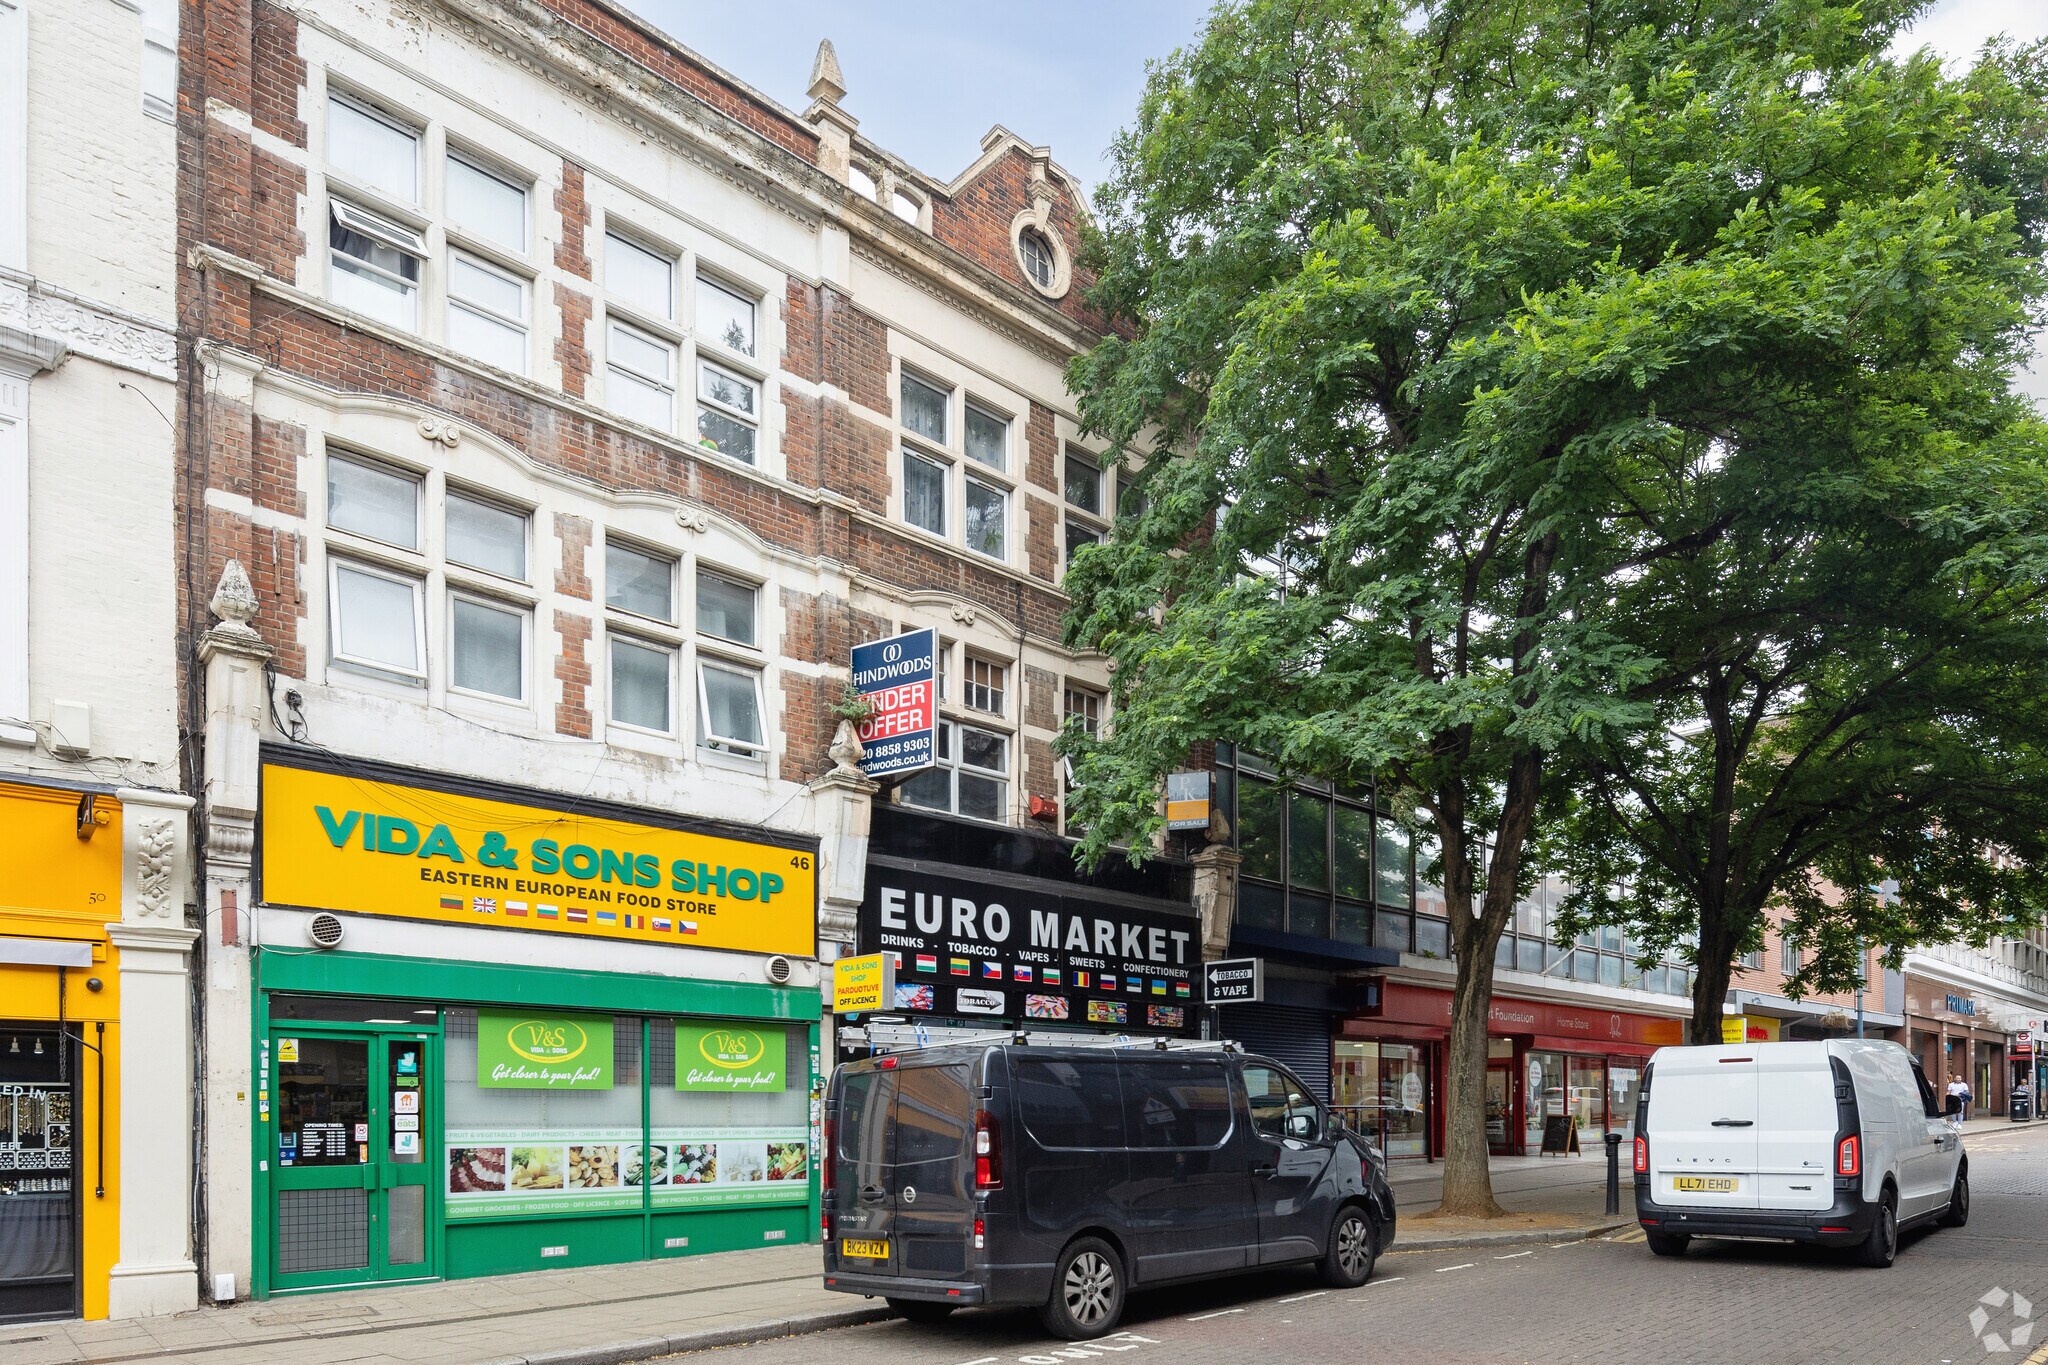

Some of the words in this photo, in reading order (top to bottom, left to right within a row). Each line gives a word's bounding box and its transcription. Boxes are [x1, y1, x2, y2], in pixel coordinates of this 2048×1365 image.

[853, 655, 931, 686] HINDWOODS
[860, 708, 923, 739] OFFER
[875, 742, 901, 758] 8858
[903, 737, 930, 753] 9303
[314, 805, 465, 863] VIDA
[477, 831, 519, 870] &
[531, 838, 661, 888] SONS
[671, 859, 785, 903] SHOP
[790, 856, 809, 870] 46
[420, 867, 508, 890] EASTERN
[515, 879, 611, 903] EUROPEAN
[617, 892, 661, 909] FOOD
[666, 899, 717, 915] STORE
[88, 892, 106, 905] 50
[880, 886, 1011, 943] EURO
[1030, 909, 1190, 964] MARKET
[880, 934, 925, 949] DRINKS
[947, 941, 997, 957] TOBACCO
[1018, 950, 1050, 963] VAPES
[1069, 956, 1106, 969] SWEETS
[1123, 962, 1189, 978] CONFECTIONERY
[861, 961, 878, 970] SONS
[850, 974, 866, 982] SHOP
[1216, 969, 1248, 980] TOBACCO
[1213, 987, 1220, 997] &
[1222, 984, 1248, 996] VAPE
[852, 996, 877, 1004] LICENCE
[960, 998, 996, 1006] TOBACCO
[1946, 993, 1977, 1017] PRIMARK
[1495, 1007, 1534, 1024] Foundation
[1557, 1016, 1574, 1028] Home
[1574, 1017, 1590, 1030] Store
[528, 1026, 565, 1047] V&S
[715, 1034, 747, 1055] V&S
[491, 1063, 511, 1079] Get
[511, 1065, 538, 1079] closer
[539, 1068, 549, 1079] to
[549, 1072, 571, 1084] your
[570, 1066, 601, 1085] food!
[686, 1068, 702, 1085] Get
[701, 1070, 724, 1084] closer
[725, 1071, 734, 1083] to
[733, 1075, 752, 1088] your
[750, 1071, 776, 1088] food!
[29, 1087, 47, 1101] IN
[476, 1131, 517, 1139] VEGETABLES
[1680, 1178, 1706, 1189] LL71
[1708, 1179, 1731, 1190] EHD
[449, 1206, 483, 1214] GOURMET
[484, 1204, 520, 1212] GROCERIES
[846, 1240, 867, 1254] BK23
